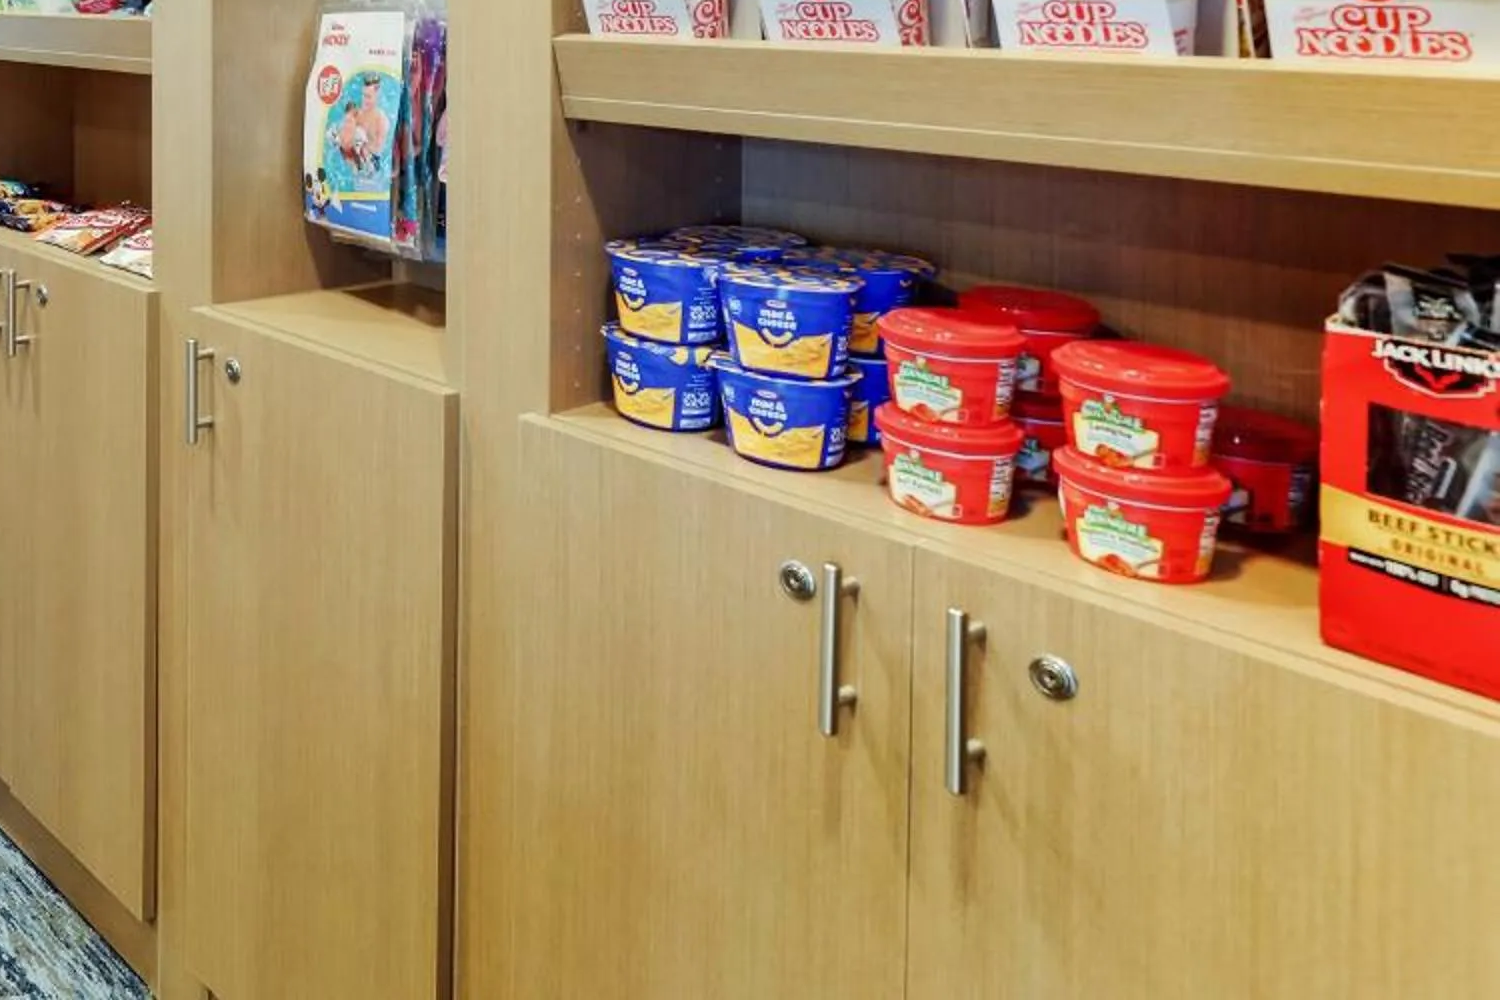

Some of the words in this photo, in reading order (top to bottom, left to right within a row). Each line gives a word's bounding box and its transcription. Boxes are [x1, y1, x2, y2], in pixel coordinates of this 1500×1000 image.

[796, 2, 852, 22] CUP
[1043, 0, 1116, 23] CUP
[1331, 5, 1432, 32] CUP
[598, 14, 678, 36] NOODLES
[780, 19, 881, 42] NOODLES
[1018, 21, 1149, 49] NOODLES
[1297, 28, 1473, 61] NOODLES
[1370, 339, 1432, 368] JACK
[1368, 508, 1417, 533] BEEF
[1391, 538, 1484, 576] ORIGINAL
